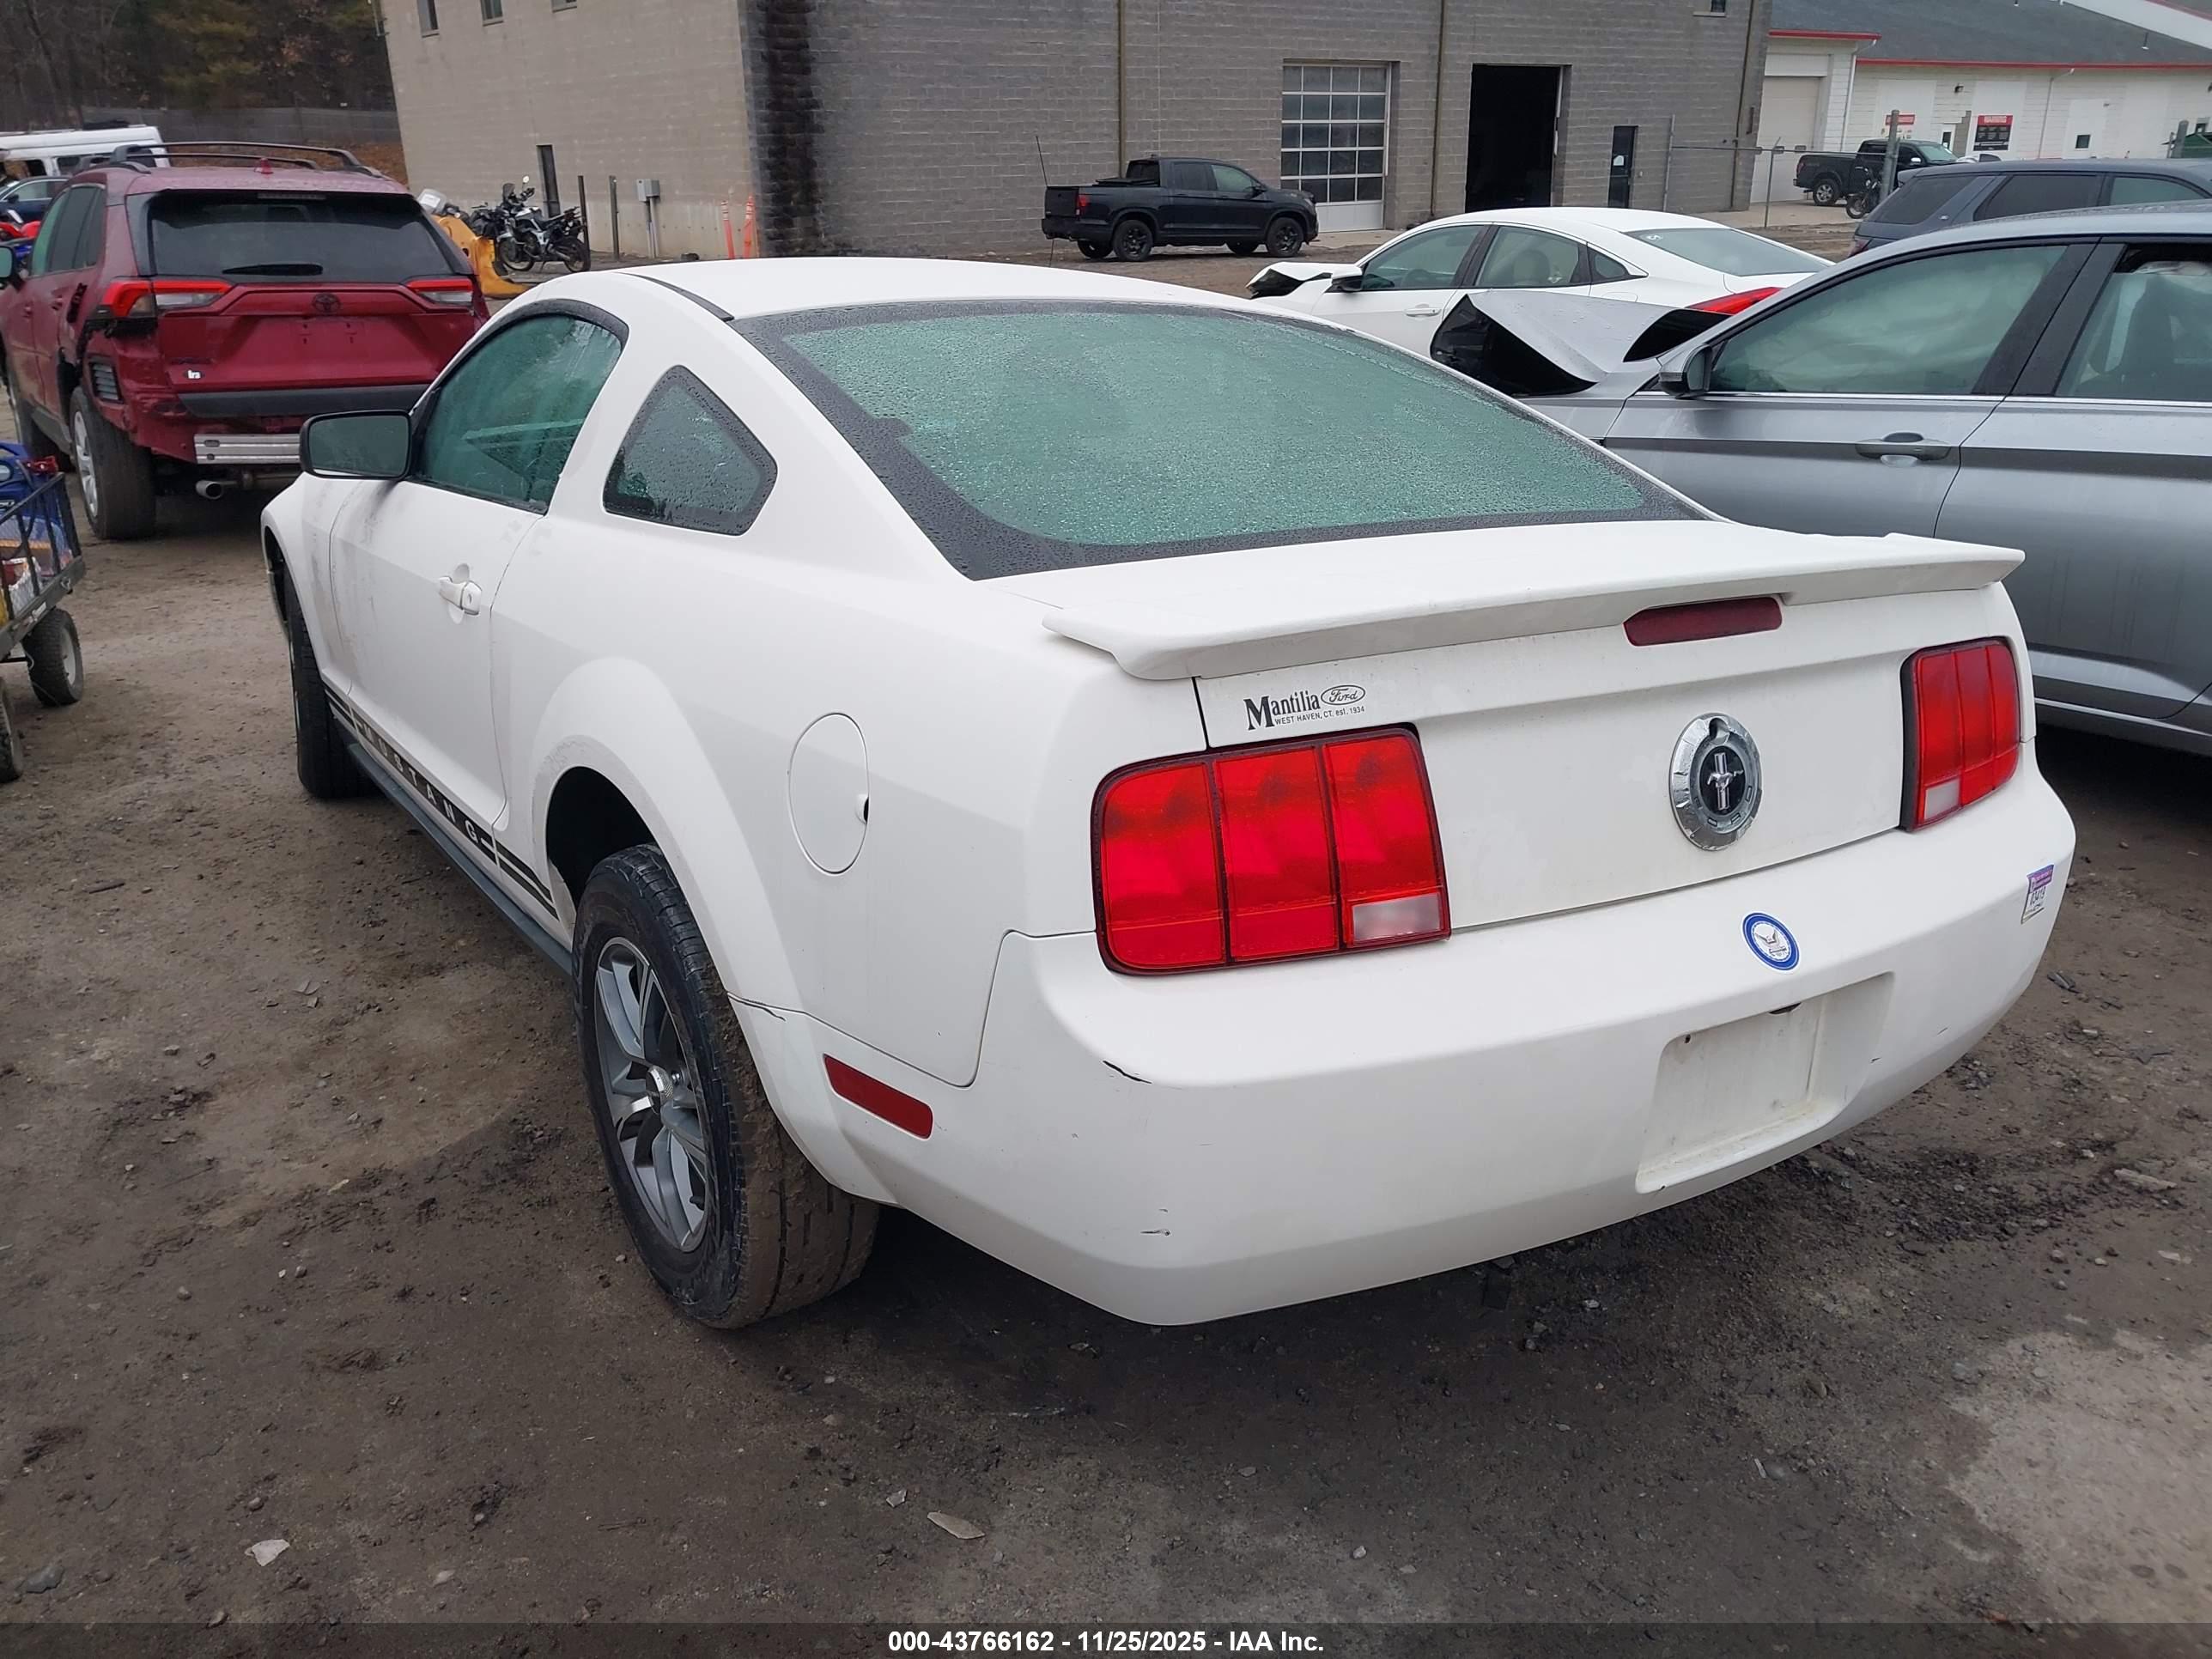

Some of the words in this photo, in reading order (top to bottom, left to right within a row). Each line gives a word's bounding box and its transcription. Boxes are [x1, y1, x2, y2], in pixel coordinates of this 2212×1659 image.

[1329, 688, 1358, 702] Ford
[1274, 715, 1295, 725] WEST
[1297, 712, 1322, 721] HAVEN,
[1349, 705, 1365, 714] 1934
